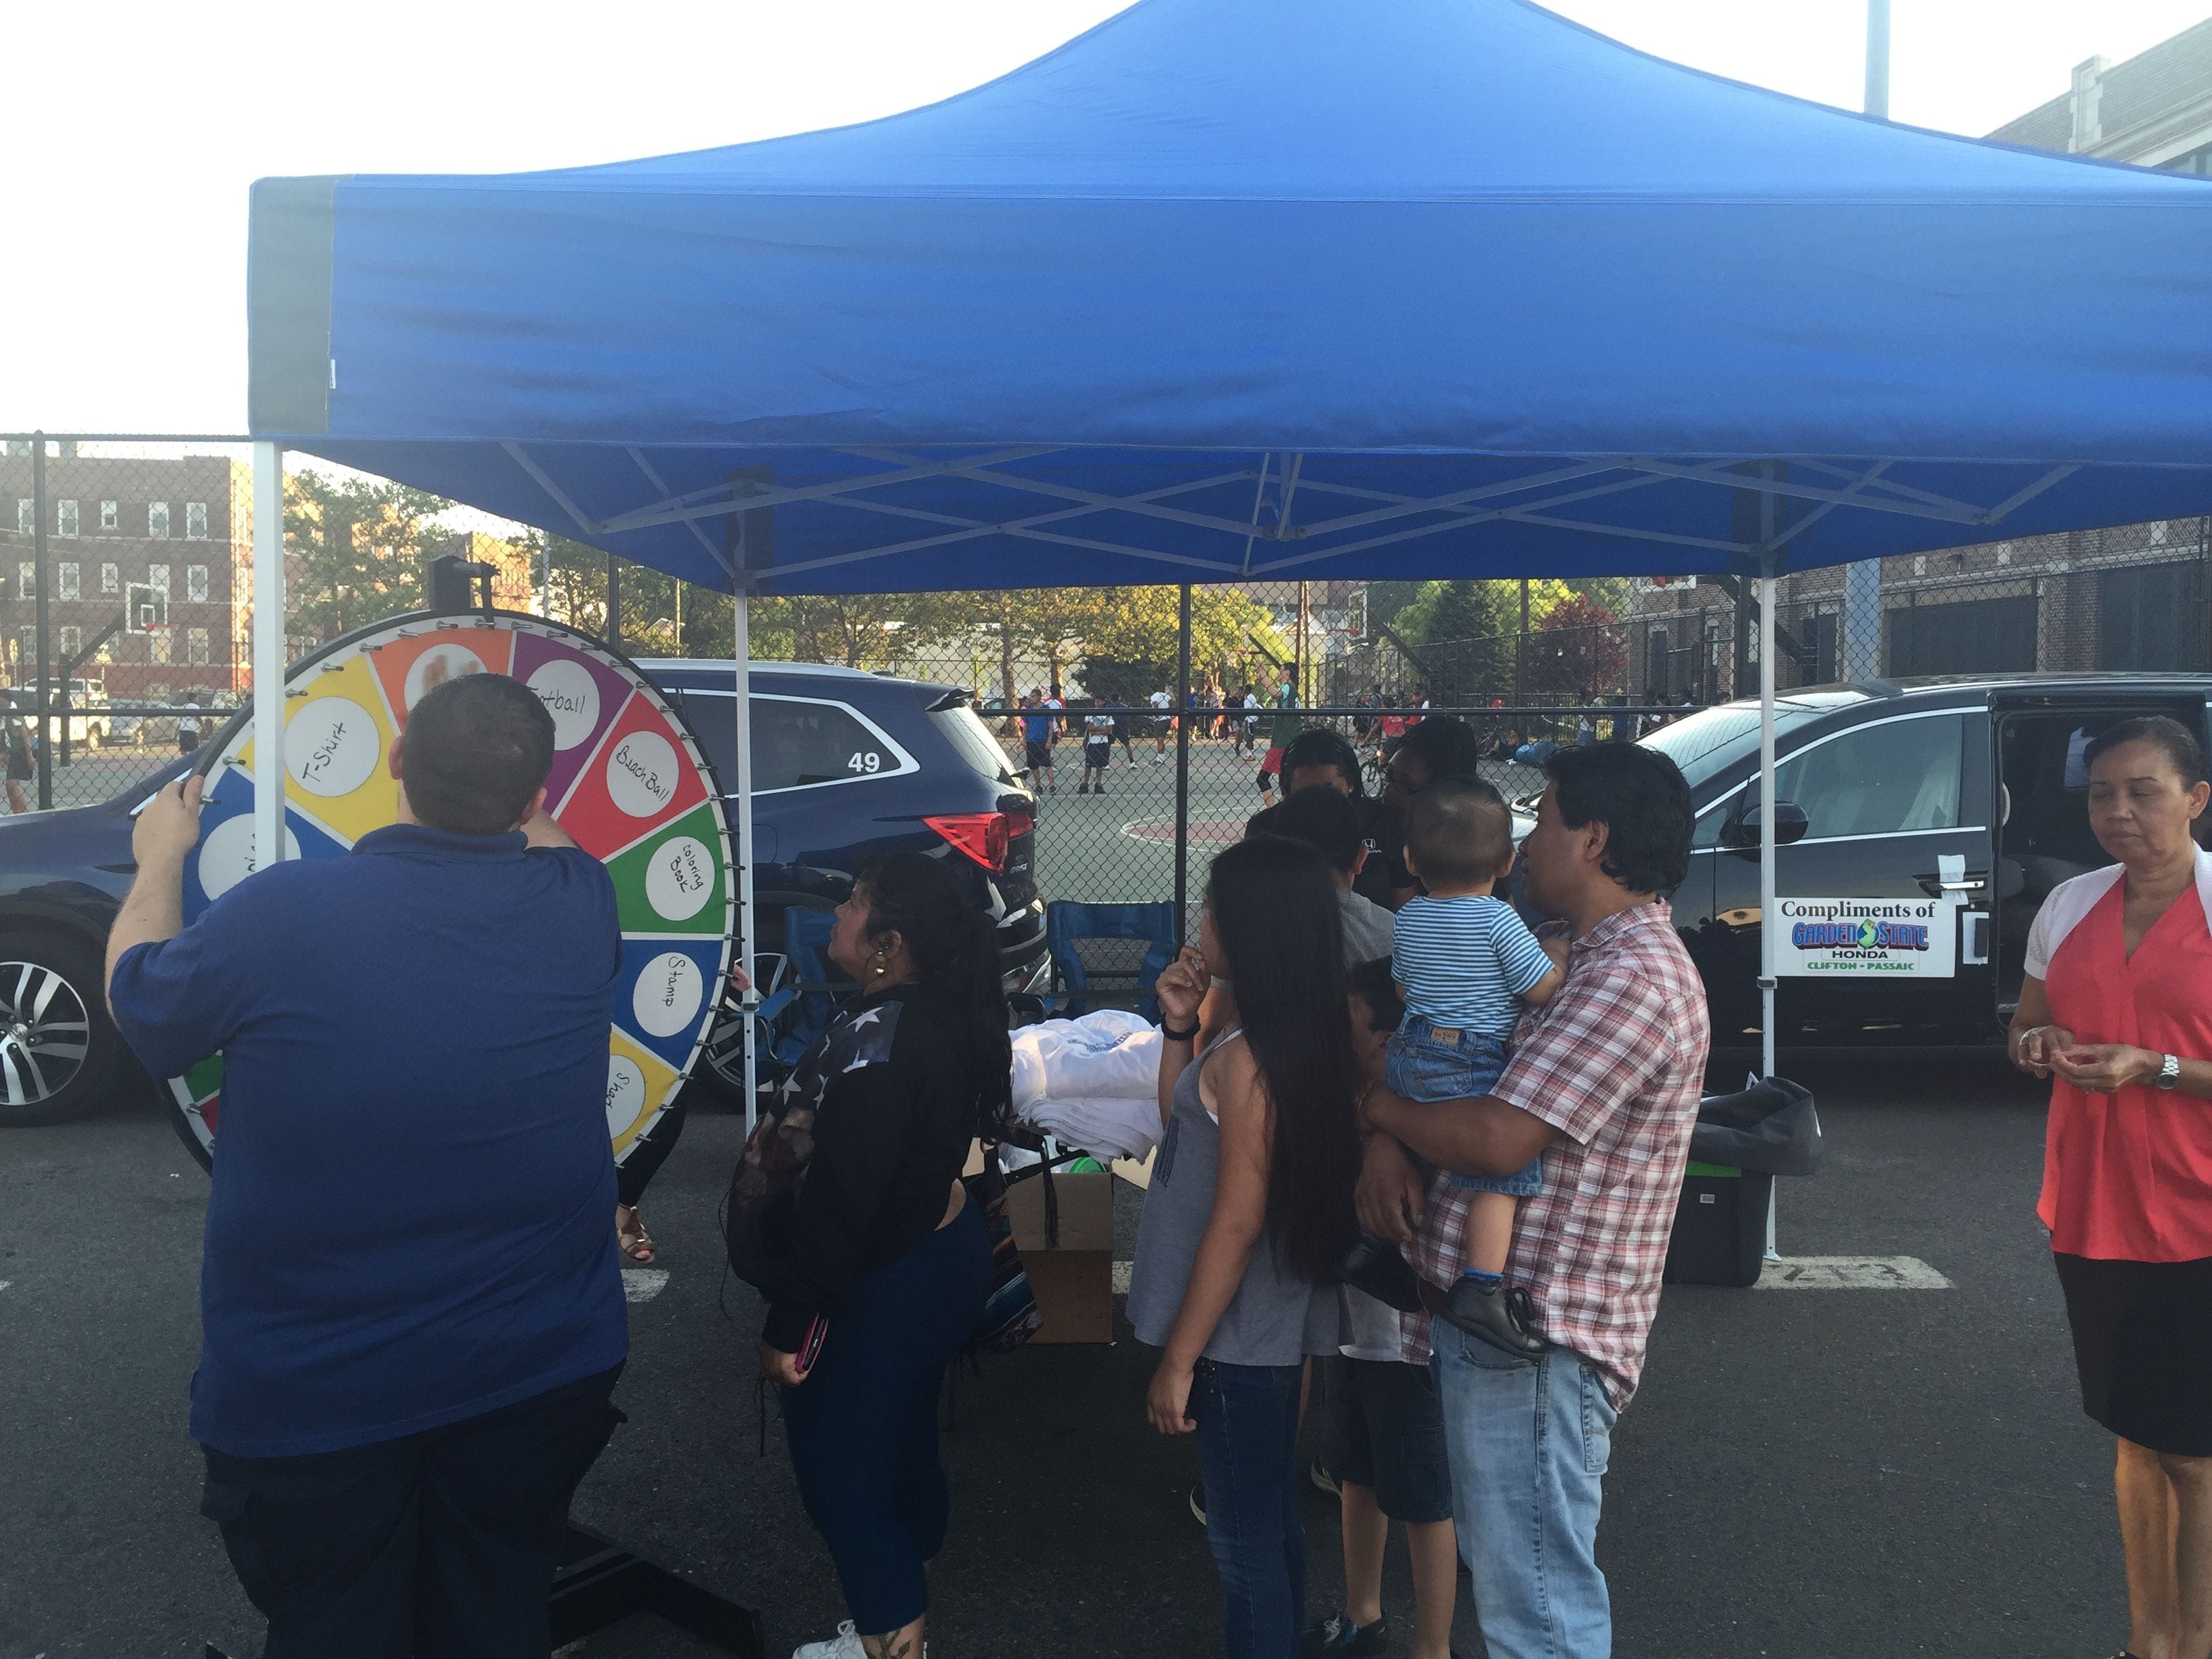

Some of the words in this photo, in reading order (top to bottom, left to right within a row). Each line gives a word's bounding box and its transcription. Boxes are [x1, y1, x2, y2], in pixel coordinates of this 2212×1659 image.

[529, 687, 586, 714] tball
[302, 722, 347, 783] T-Shirt
[848, 752, 880, 773] 49
[646, 772, 670, 802] Ball
[1781, 901, 1911, 922] Compliments
[1916, 901, 1936, 918] of
[1792, 922, 1858, 950] GARDEN
[1877, 920, 1929, 951] STATE
[1832, 950, 1889, 959] HONDA
[1867, 962, 1914, 970] PASSAIC
[661, 956, 686, 1007] Stamp
